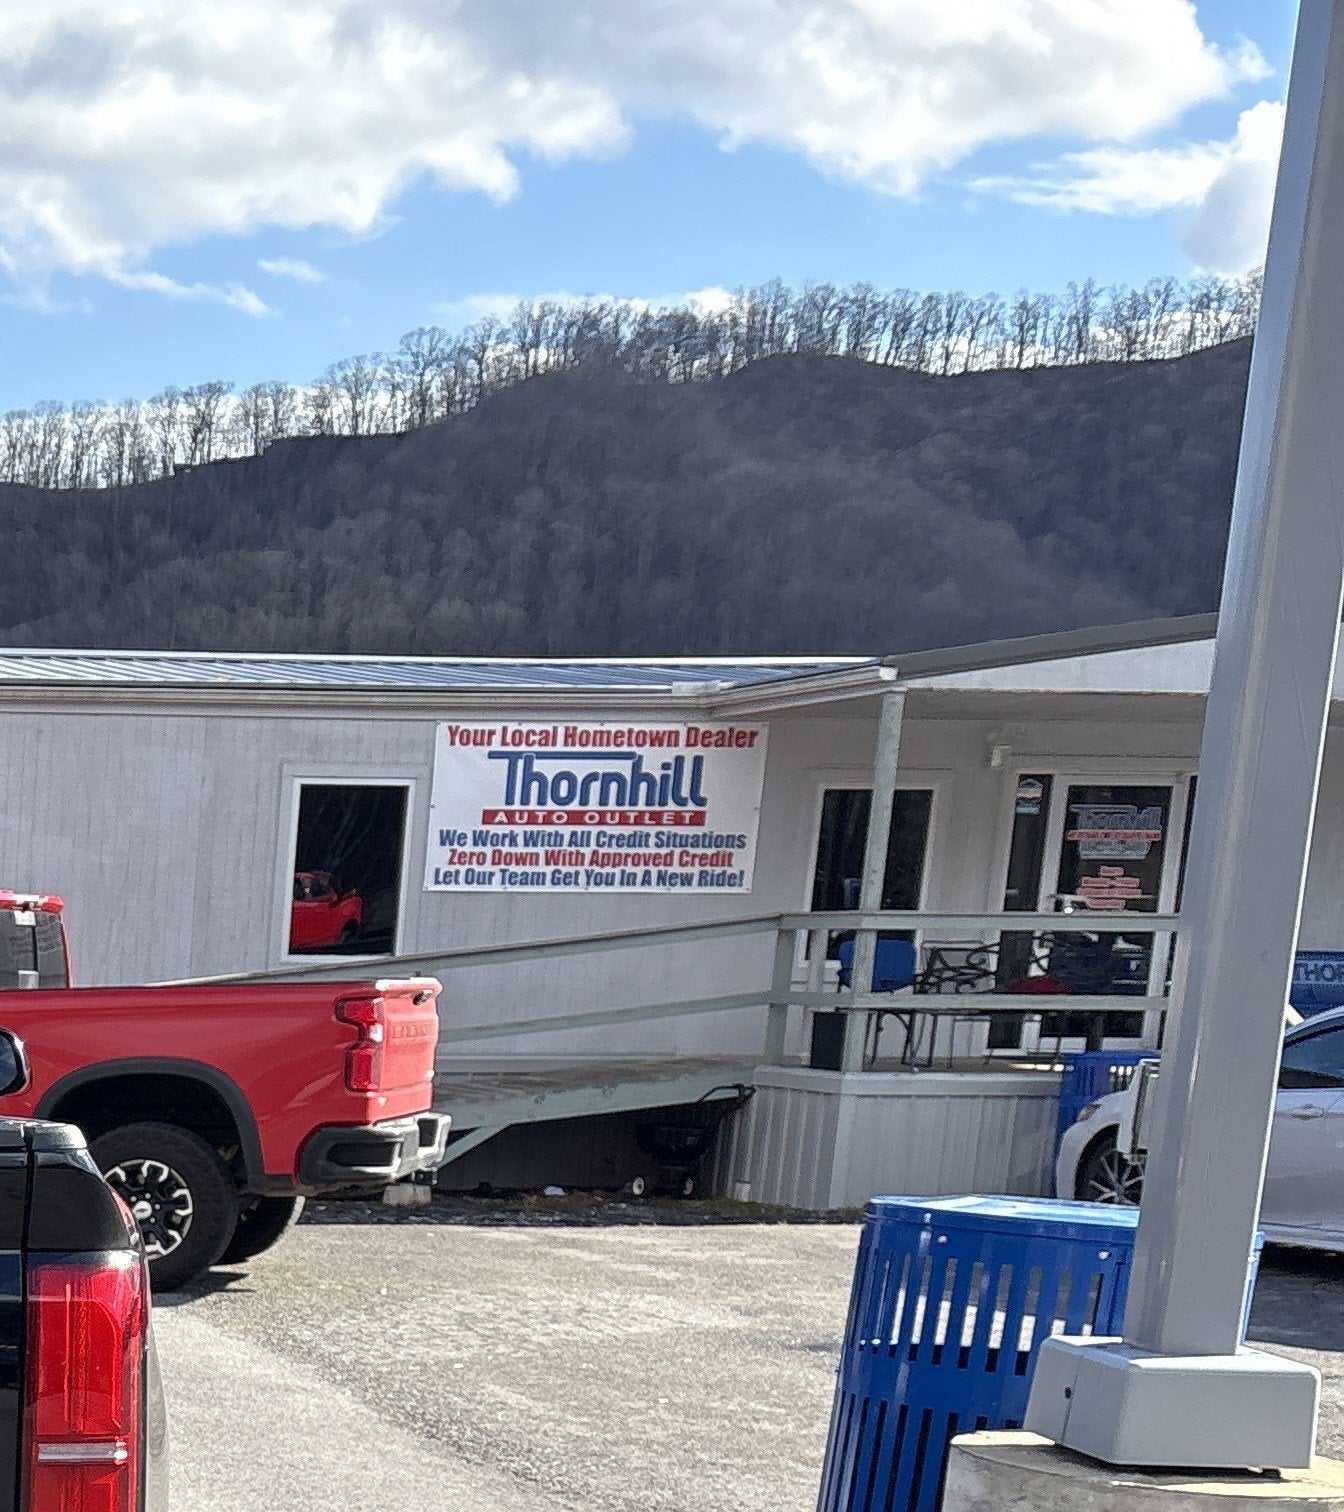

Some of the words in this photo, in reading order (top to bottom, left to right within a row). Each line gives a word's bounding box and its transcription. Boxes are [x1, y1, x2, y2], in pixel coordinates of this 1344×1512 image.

[447, 725, 496, 747] Your
[501, 725, 558, 747] Local
[563, 726, 680, 748] Hometown
[686, 726, 758, 748] Dealer
[487, 750, 708, 807] Thornhill
[493, 811, 568, 824] AUTO
[584, 811, 695, 824] OUTLET
[439, 829, 468, 847] We
[472, 829, 519, 847] Work
[523, 829, 564, 848] With
[567, 830, 592, 848] All
[596, 830, 651, 848] Credit
[654, 830, 747, 849] Situations
[448, 848, 487, 866] Zero
[491, 849, 540, 866] Down
[544, 849, 586, 867] With
[589, 849, 675, 868] Approved
[678, 850, 734, 867] Credit
[434, 867, 460, 885] Let
[464, 868, 496, 885] Our
[499, 868, 547, 886] Team
[550, 869, 580, 886] Get
[584, 869, 616, 886] You
[619, 869, 637, 886] In
[641, 869, 652, 886] A
[656, 870, 694, 886] New
[698, 870, 745, 887] Ride!
